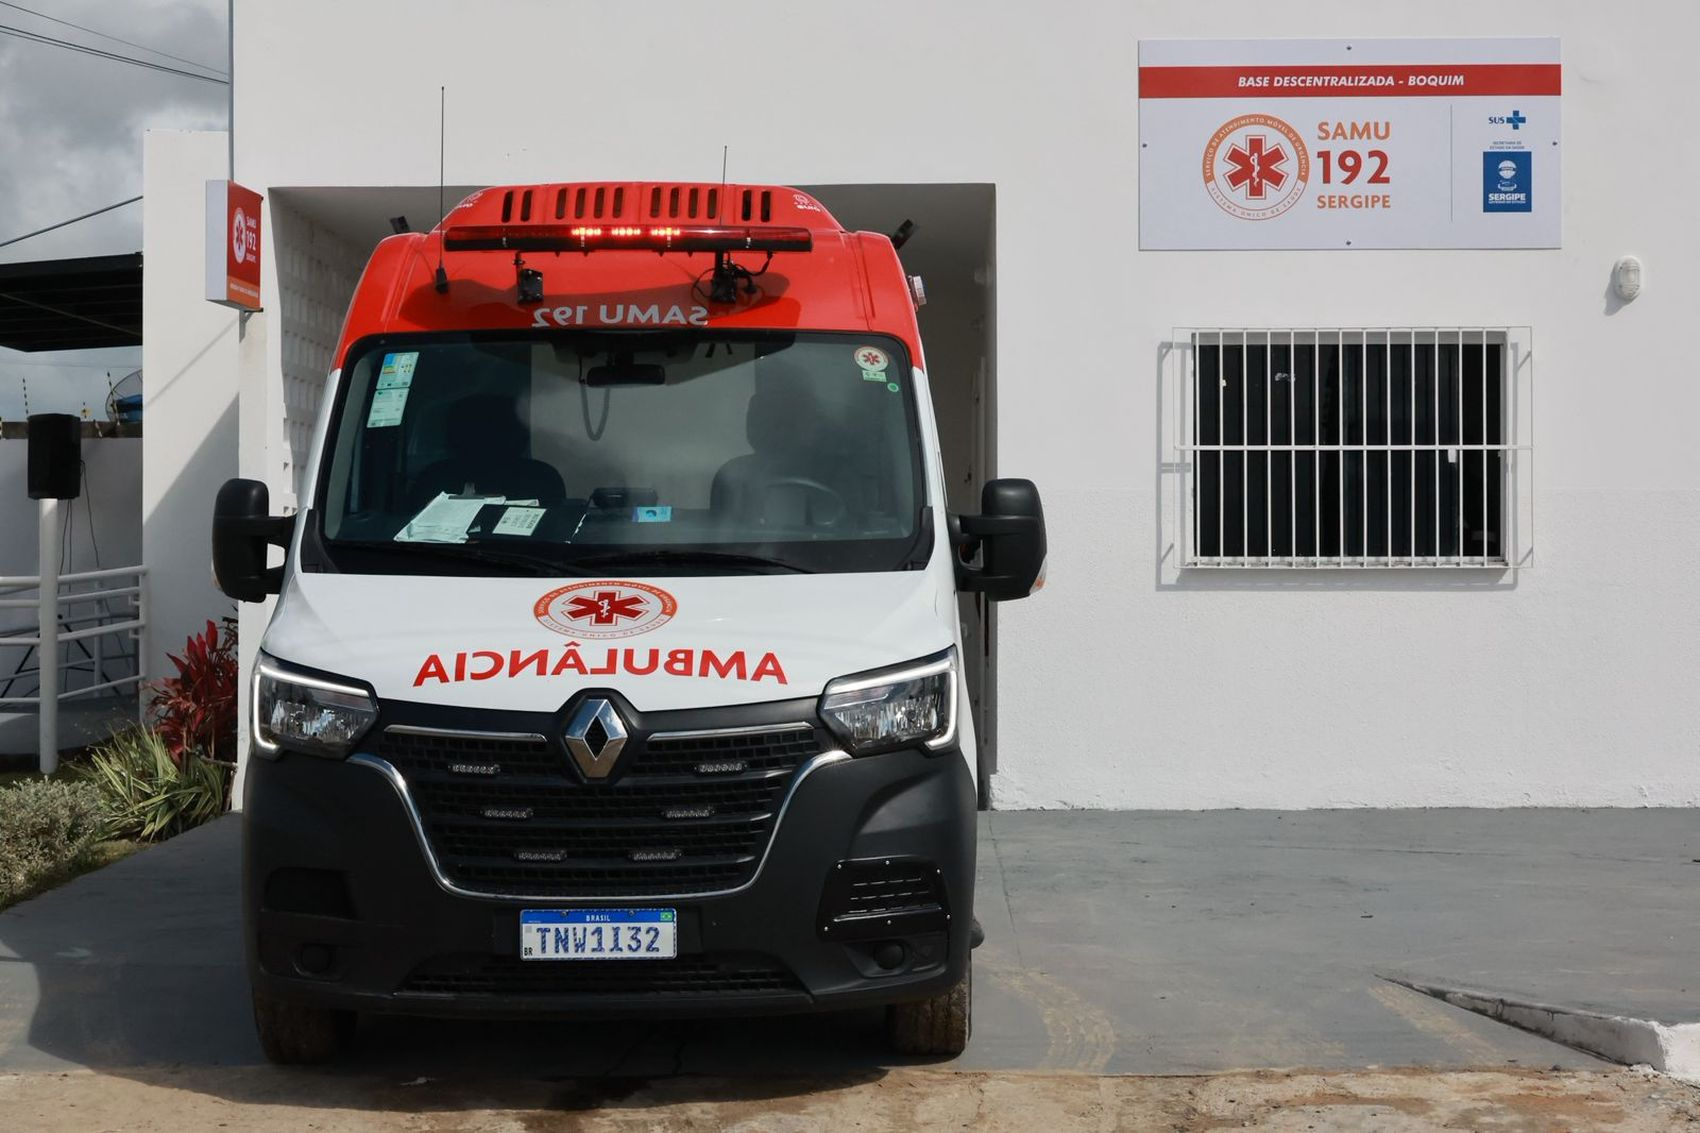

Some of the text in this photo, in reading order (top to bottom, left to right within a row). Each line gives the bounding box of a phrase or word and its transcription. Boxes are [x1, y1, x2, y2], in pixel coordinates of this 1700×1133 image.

[1238, 76, 1270, 87] BASE
[1273, 76, 1394, 87] DESCENTRALIZADA
[1408, 75, 1464, 86] BOQUIM
[1488, 116, 1505, 124] SUS
[1317, 121, 1391, 140] SAMU
[1317, 150, 1391, 185] 192
[1317, 194, 1391, 210] SERGIPE
[1488, 193, 1526, 201] SERGIPE
[246, 230, 257, 251] 192
[524, 947, 533, 956] BR
